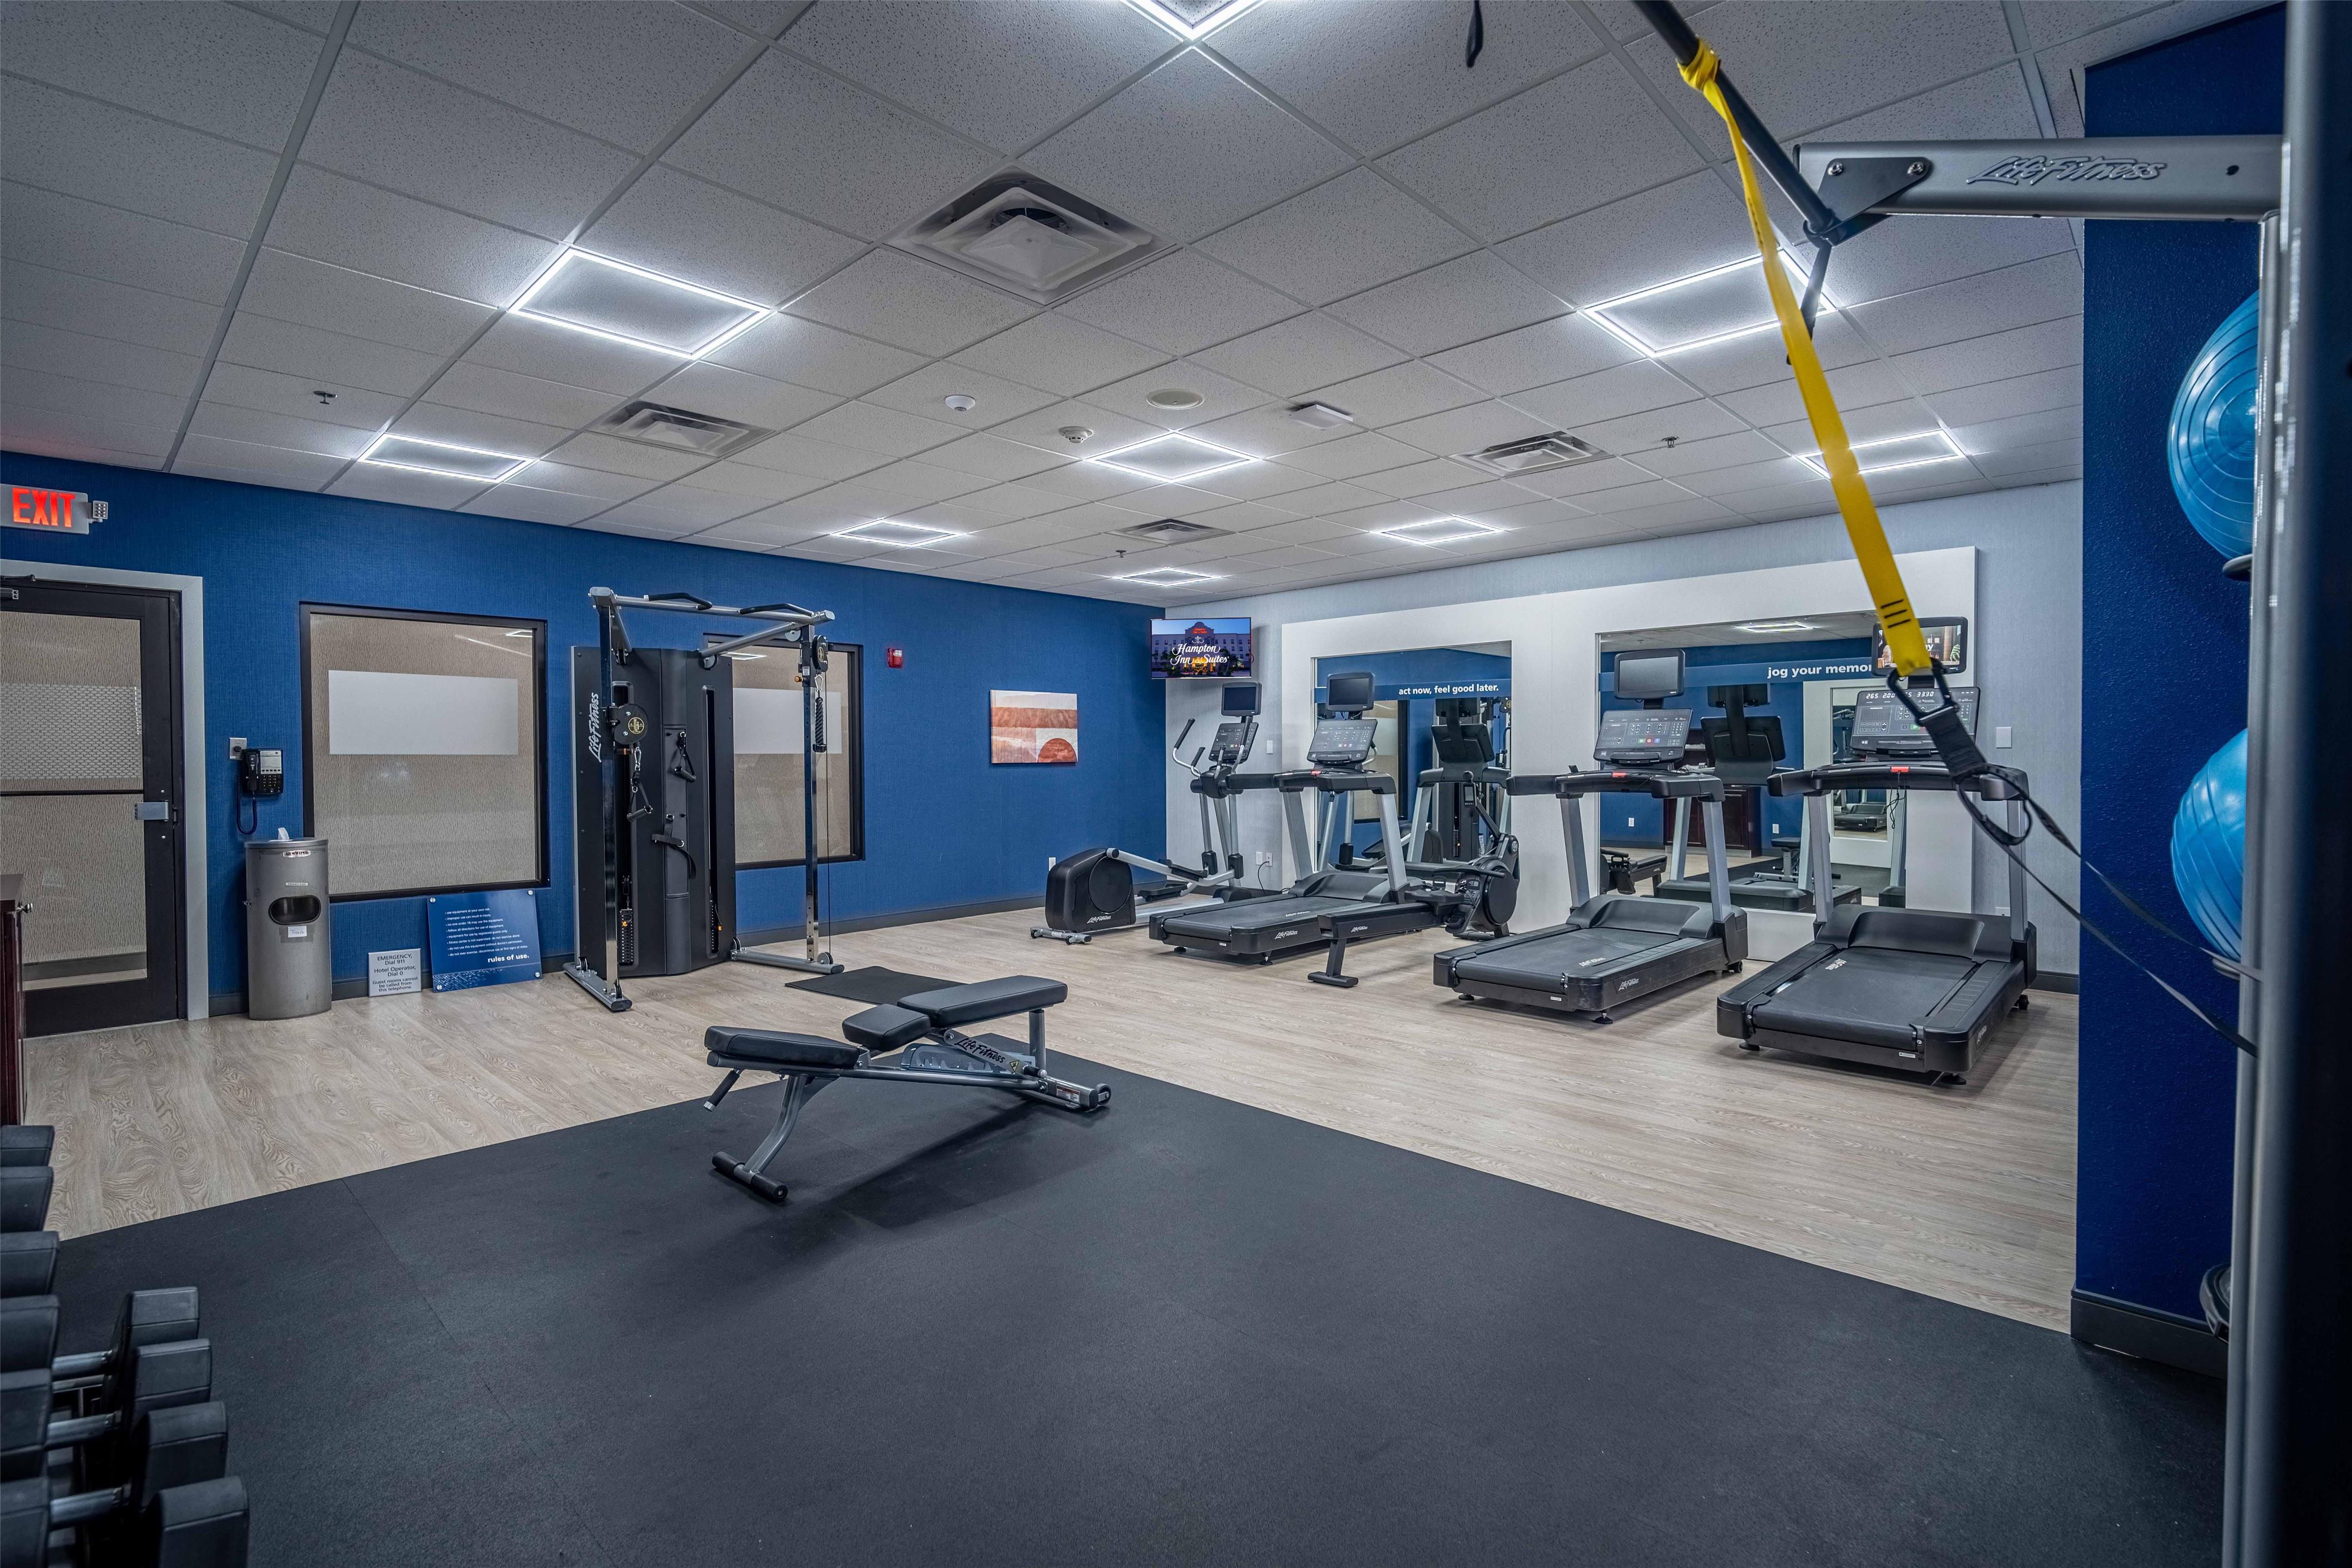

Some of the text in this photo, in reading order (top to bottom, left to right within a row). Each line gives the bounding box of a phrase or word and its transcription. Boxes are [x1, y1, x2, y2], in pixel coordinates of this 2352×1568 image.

[13, 487, 75, 528] EXIT
[1172, 643, 1220, 656] Hampton
[1170, 654, 1194, 665] Inn
[1767, 667, 1788, 678] jog
[1792, 666, 1822, 678] your
[1434, 685, 1450, 693] feel
[1452, 684, 1474, 694] good
[1477, 683, 1498, 691] later.
